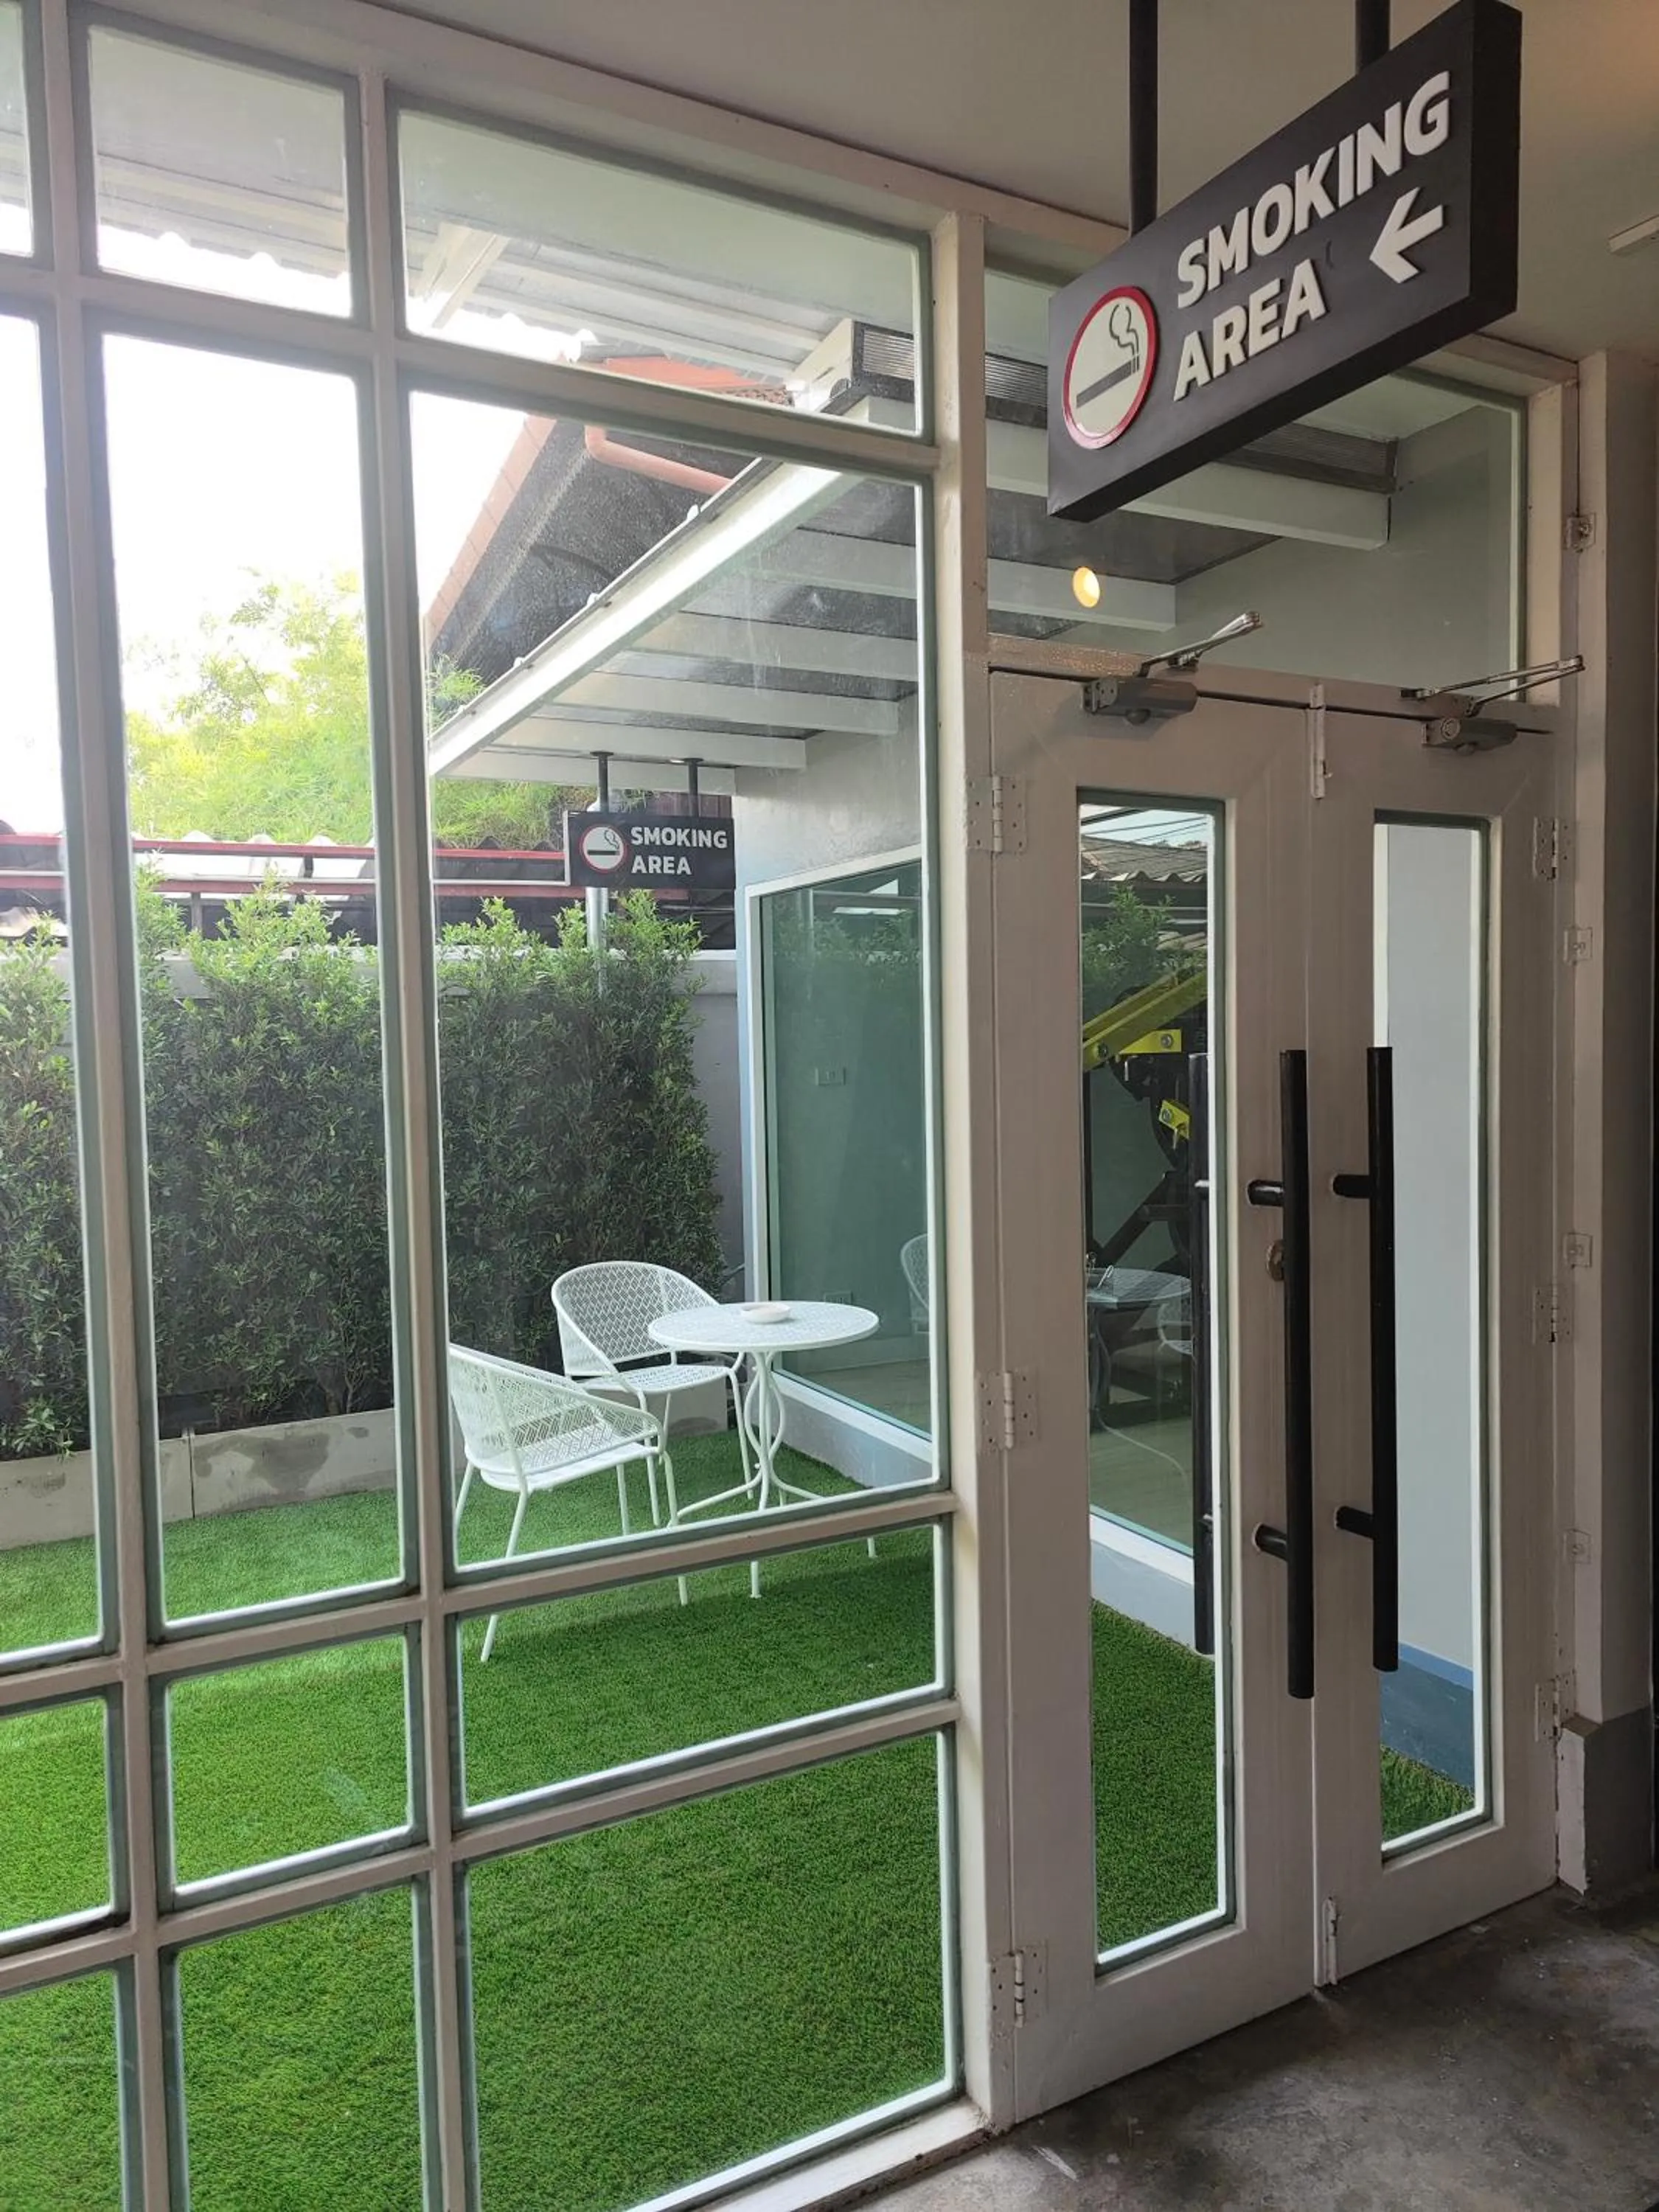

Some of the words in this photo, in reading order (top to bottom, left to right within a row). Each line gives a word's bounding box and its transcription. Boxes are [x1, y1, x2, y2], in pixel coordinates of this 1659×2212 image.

[1178, 71, 1450, 308] SMOKING
[1173, 259, 1326, 401] AREA
[630, 827, 728, 849] SMOKING
[631, 855, 692, 875] AREA
